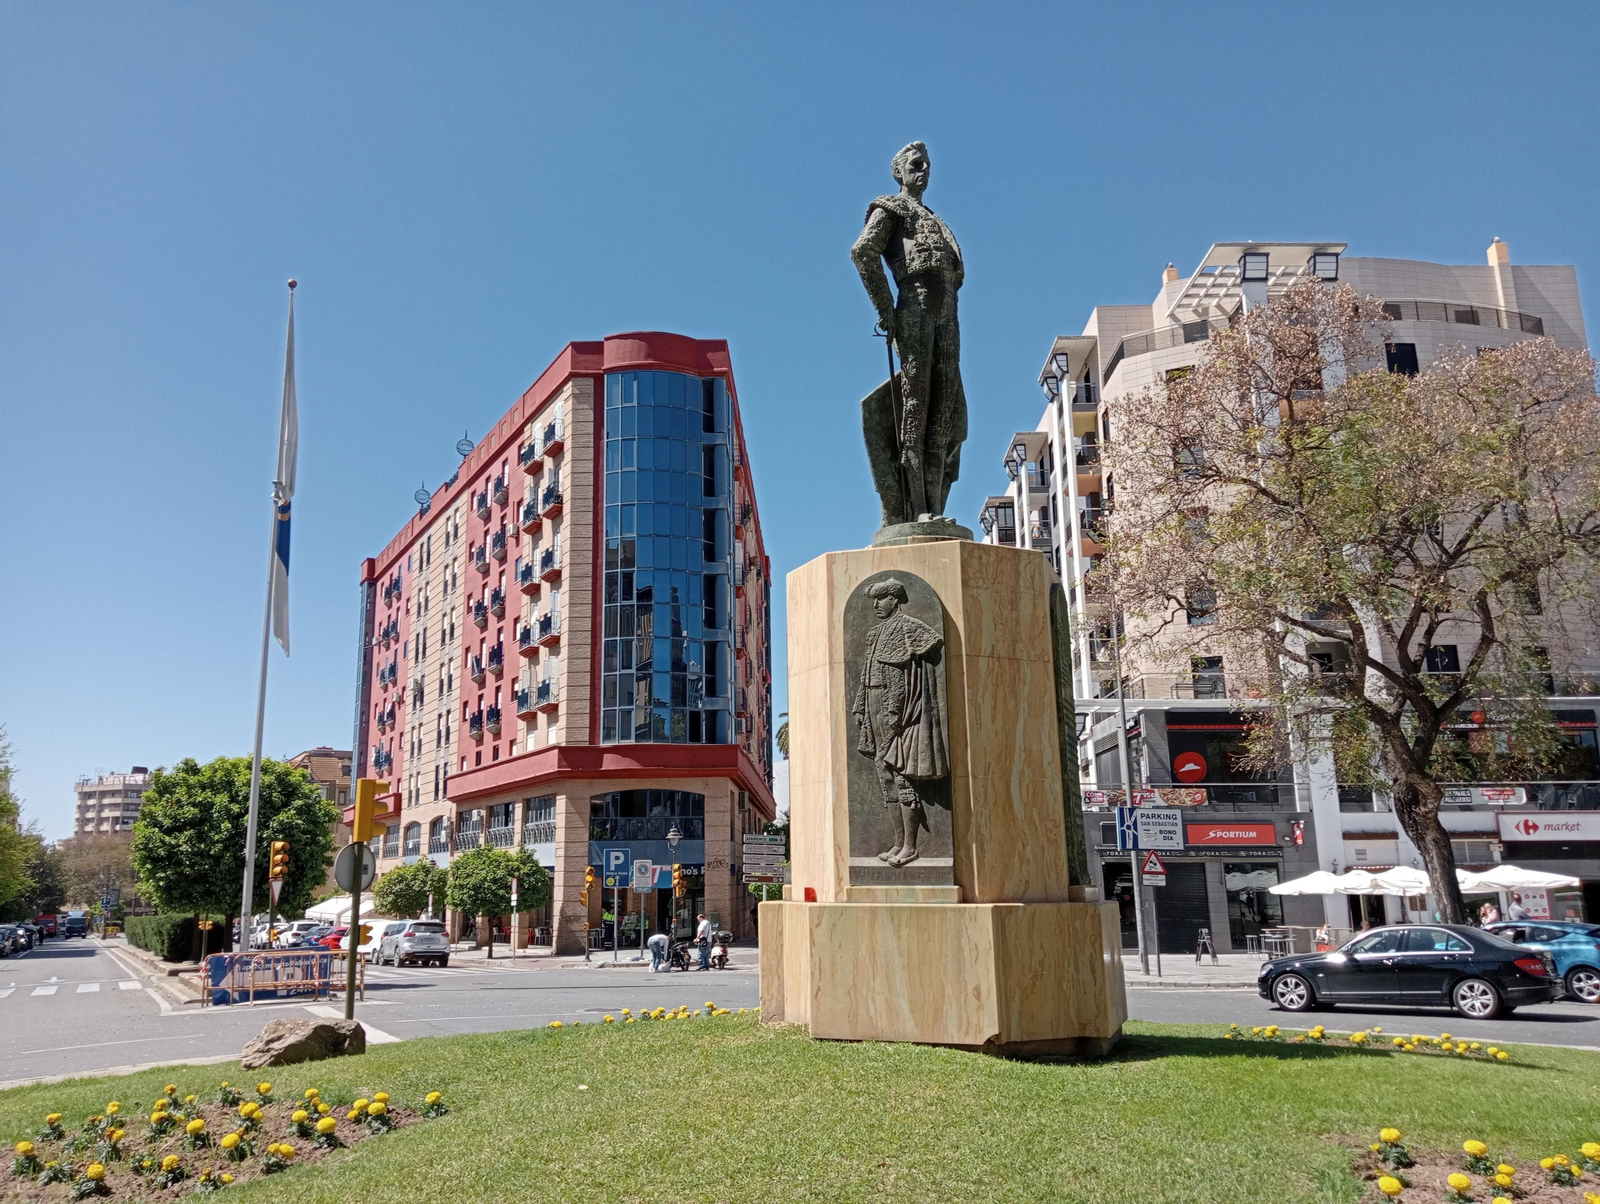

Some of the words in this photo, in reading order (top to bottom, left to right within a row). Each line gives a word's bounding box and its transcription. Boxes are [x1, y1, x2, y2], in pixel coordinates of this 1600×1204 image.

[1140, 812, 1178, 820] PARKING
[1543, 821, 1581, 833] market
[1202, 829, 1257, 840] SPORTIUM
[610, 852, 625, 871] P
